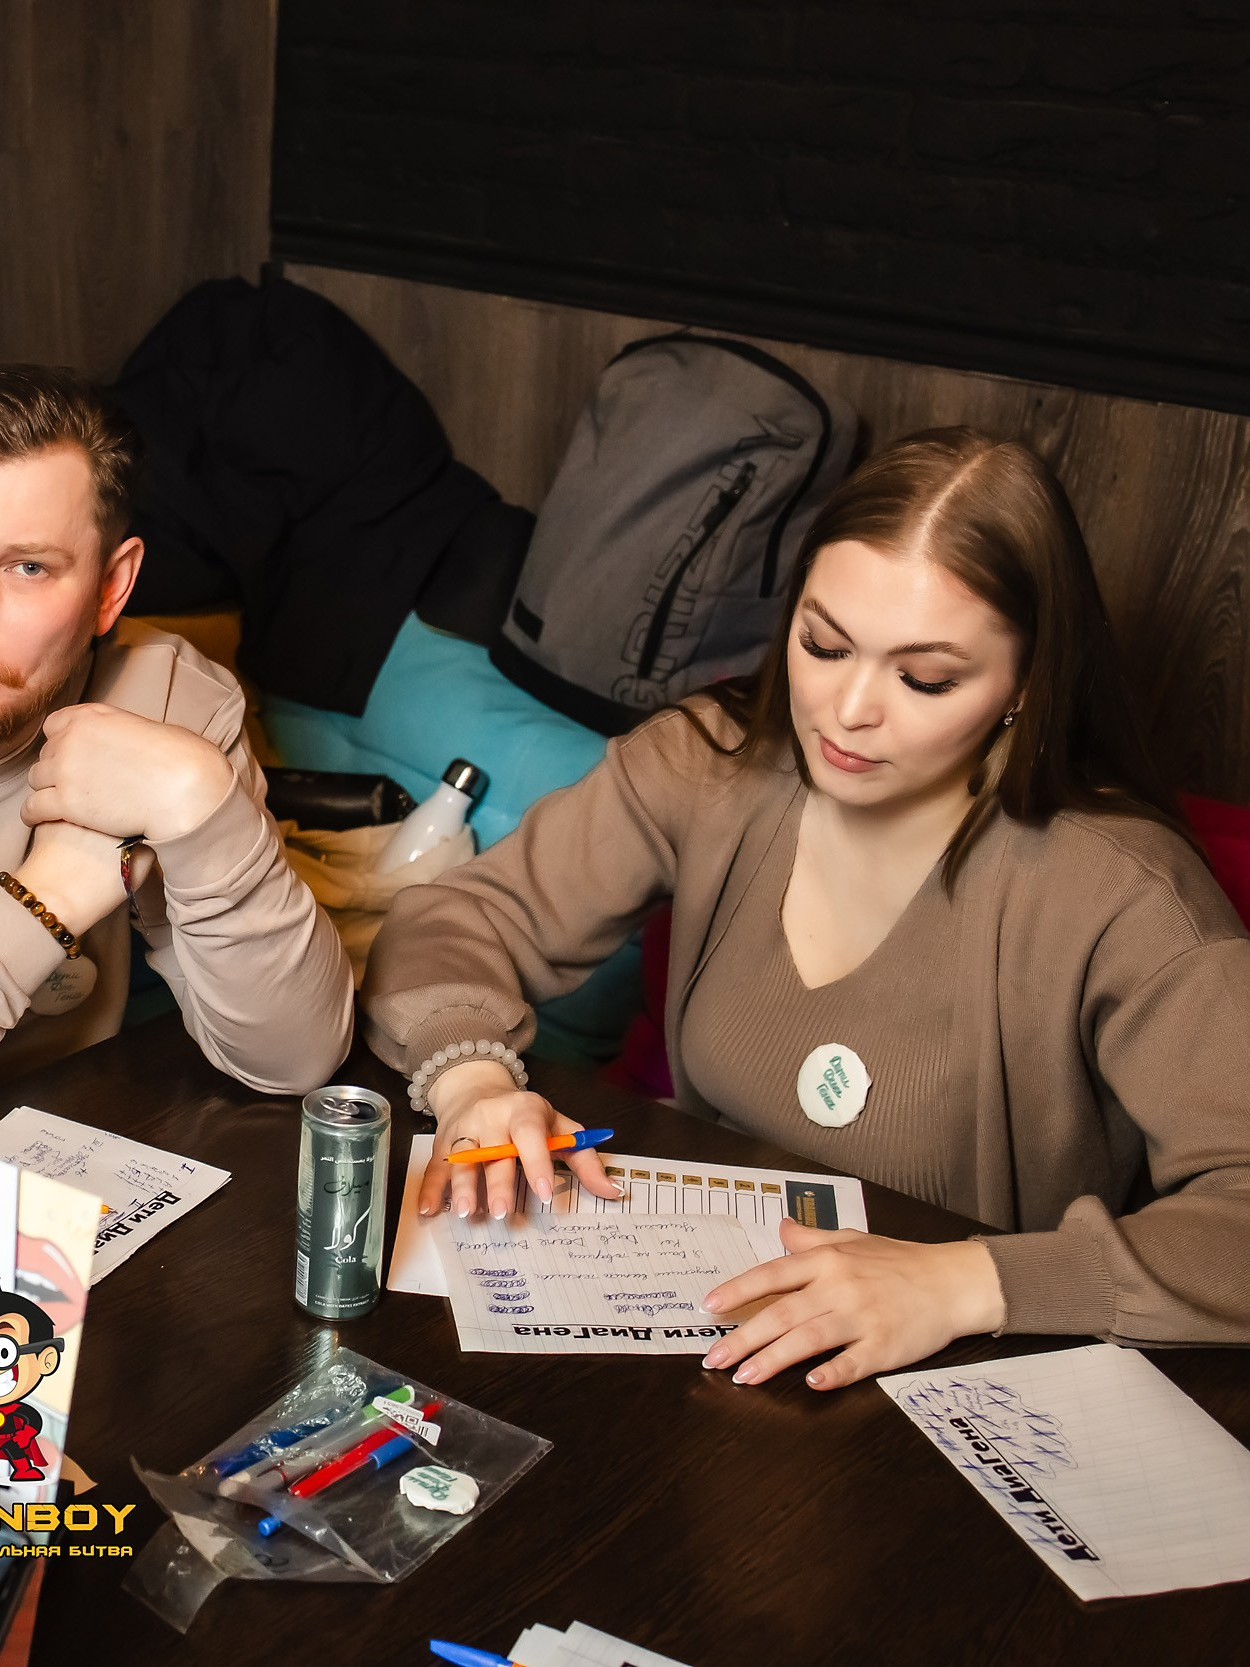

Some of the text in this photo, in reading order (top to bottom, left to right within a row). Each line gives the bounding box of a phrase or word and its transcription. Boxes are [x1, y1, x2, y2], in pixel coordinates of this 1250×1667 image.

[128, 1190, 182, 1224] Дети
[335, 1255, 357, 1264] Cola
[514, 1325, 652, 1342] ДиаГена
[949, 1417, 1045, 1504] ДиаГена
[1034, 1510, 1100, 1561] Дети
